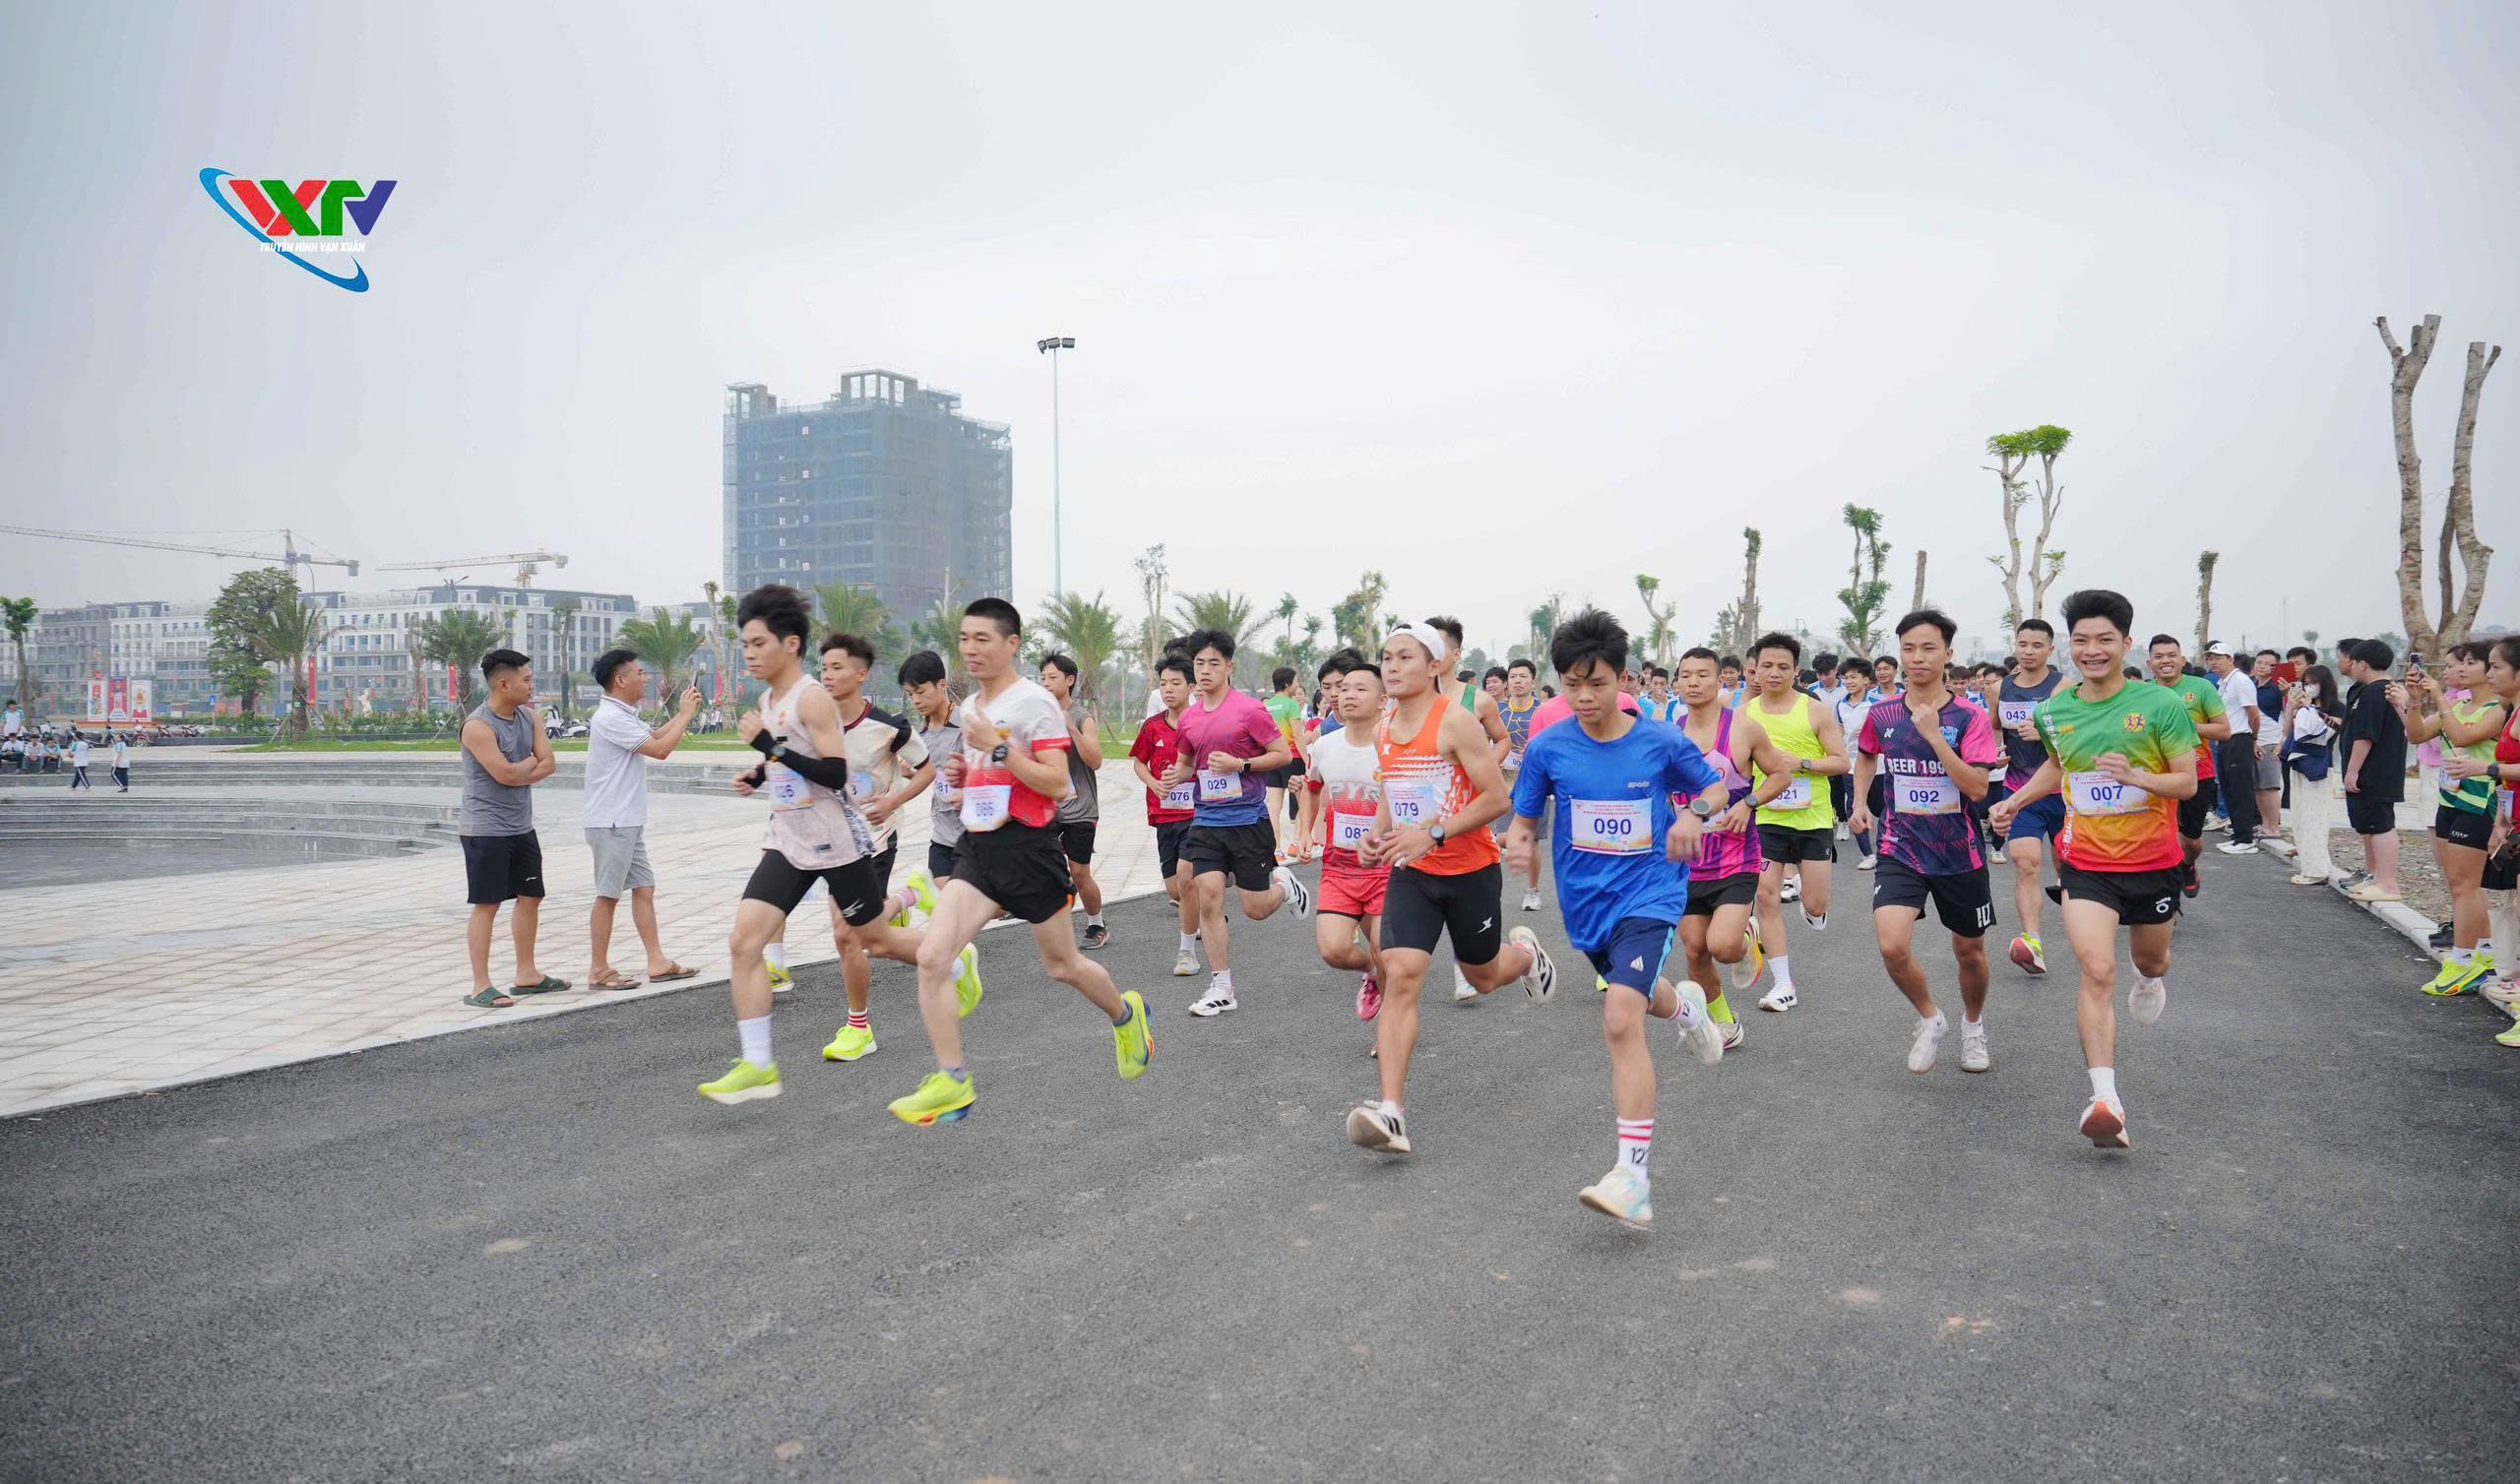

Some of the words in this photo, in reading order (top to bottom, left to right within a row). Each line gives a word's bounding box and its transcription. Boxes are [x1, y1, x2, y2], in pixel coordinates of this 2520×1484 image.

[2006, 711, 2026, 720] 043
[1207, 778, 1228, 790] 029
[1170, 791, 1190, 802] 076
[1909, 790, 1939, 803] 092
[2091, 784, 2123, 801] 007
[1394, 802, 1418, 817] 079
[1594, 818, 1632, 835] 090
[1345, 827, 1369, 839] 08
